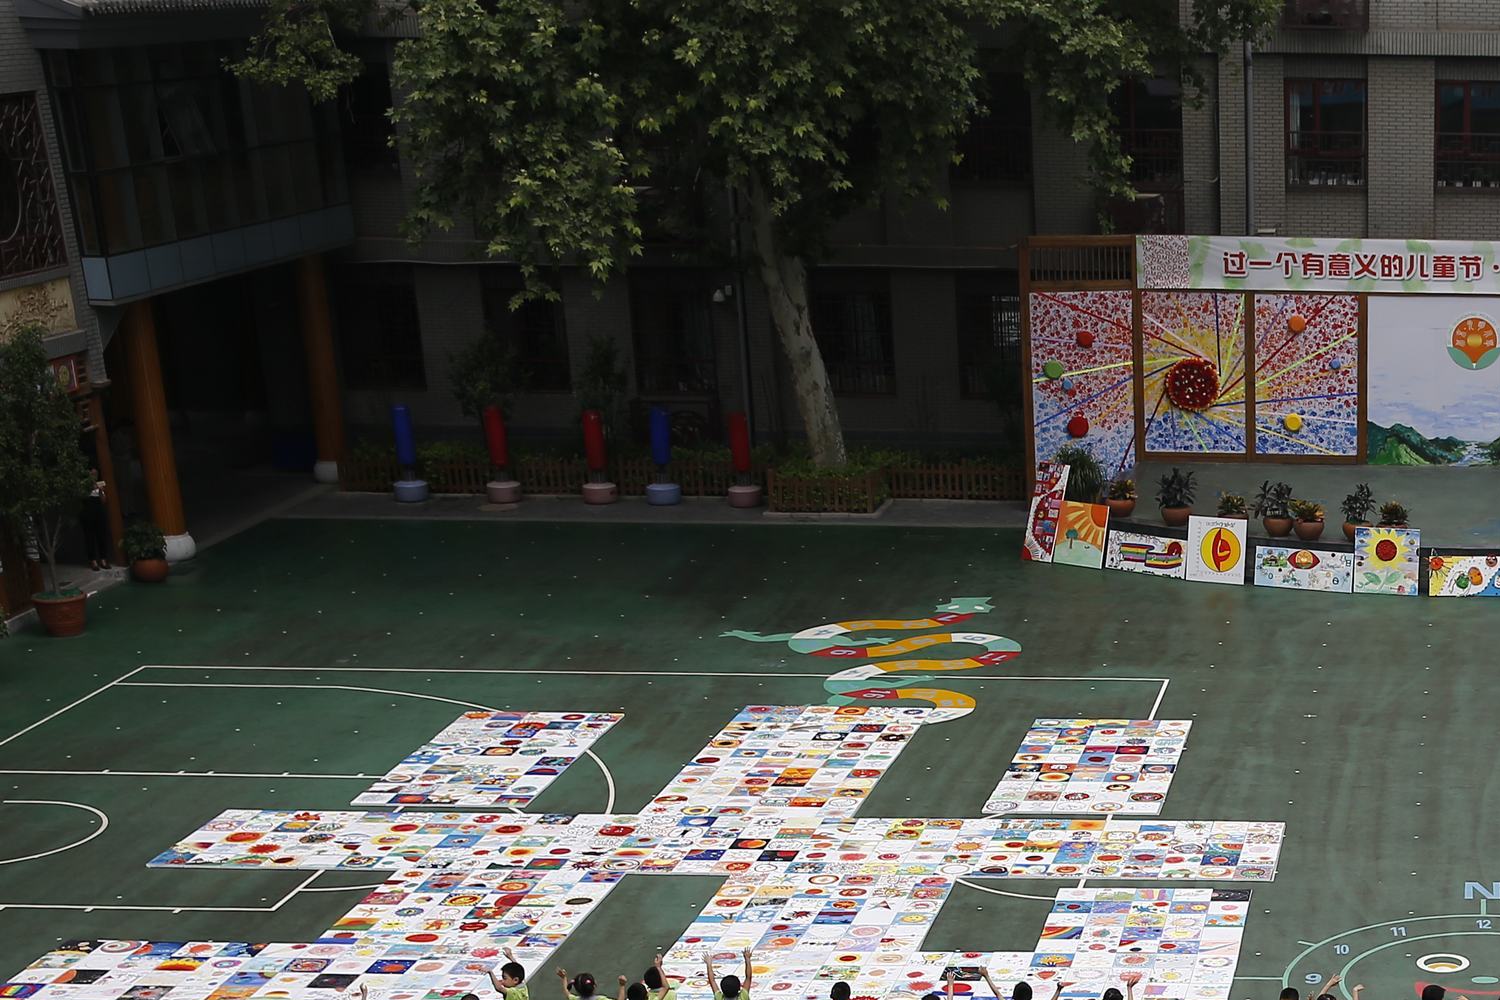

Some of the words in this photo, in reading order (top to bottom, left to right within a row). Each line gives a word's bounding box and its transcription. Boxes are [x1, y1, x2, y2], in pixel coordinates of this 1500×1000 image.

[1475, 918, 1493, 930] 12
[1389, 925, 1408, 937] 11
[1333, 943, 1350, 956] 10
[1304, 973, 1322, 985] 9
